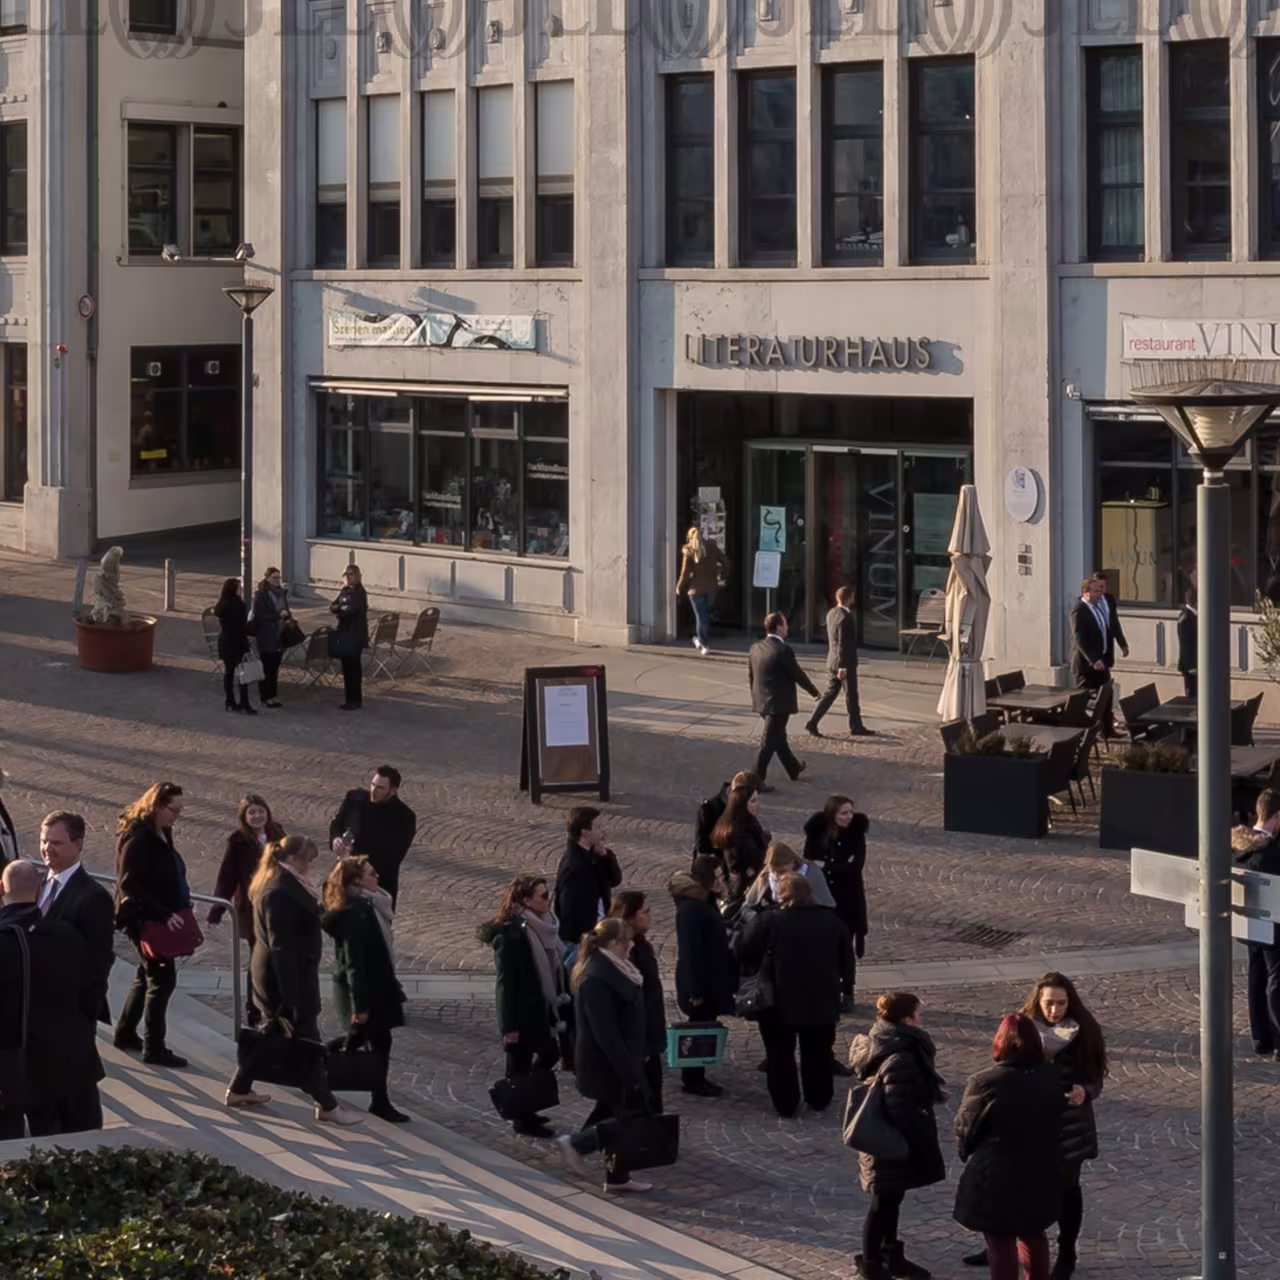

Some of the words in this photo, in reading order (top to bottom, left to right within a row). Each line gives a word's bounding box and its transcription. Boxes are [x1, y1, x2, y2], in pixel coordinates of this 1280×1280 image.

[685, 333, 932, 369] LITERATURHAUS
[1129, 337, 1196, 352] restaurant
[870, 481, 897, 621] VINUM
